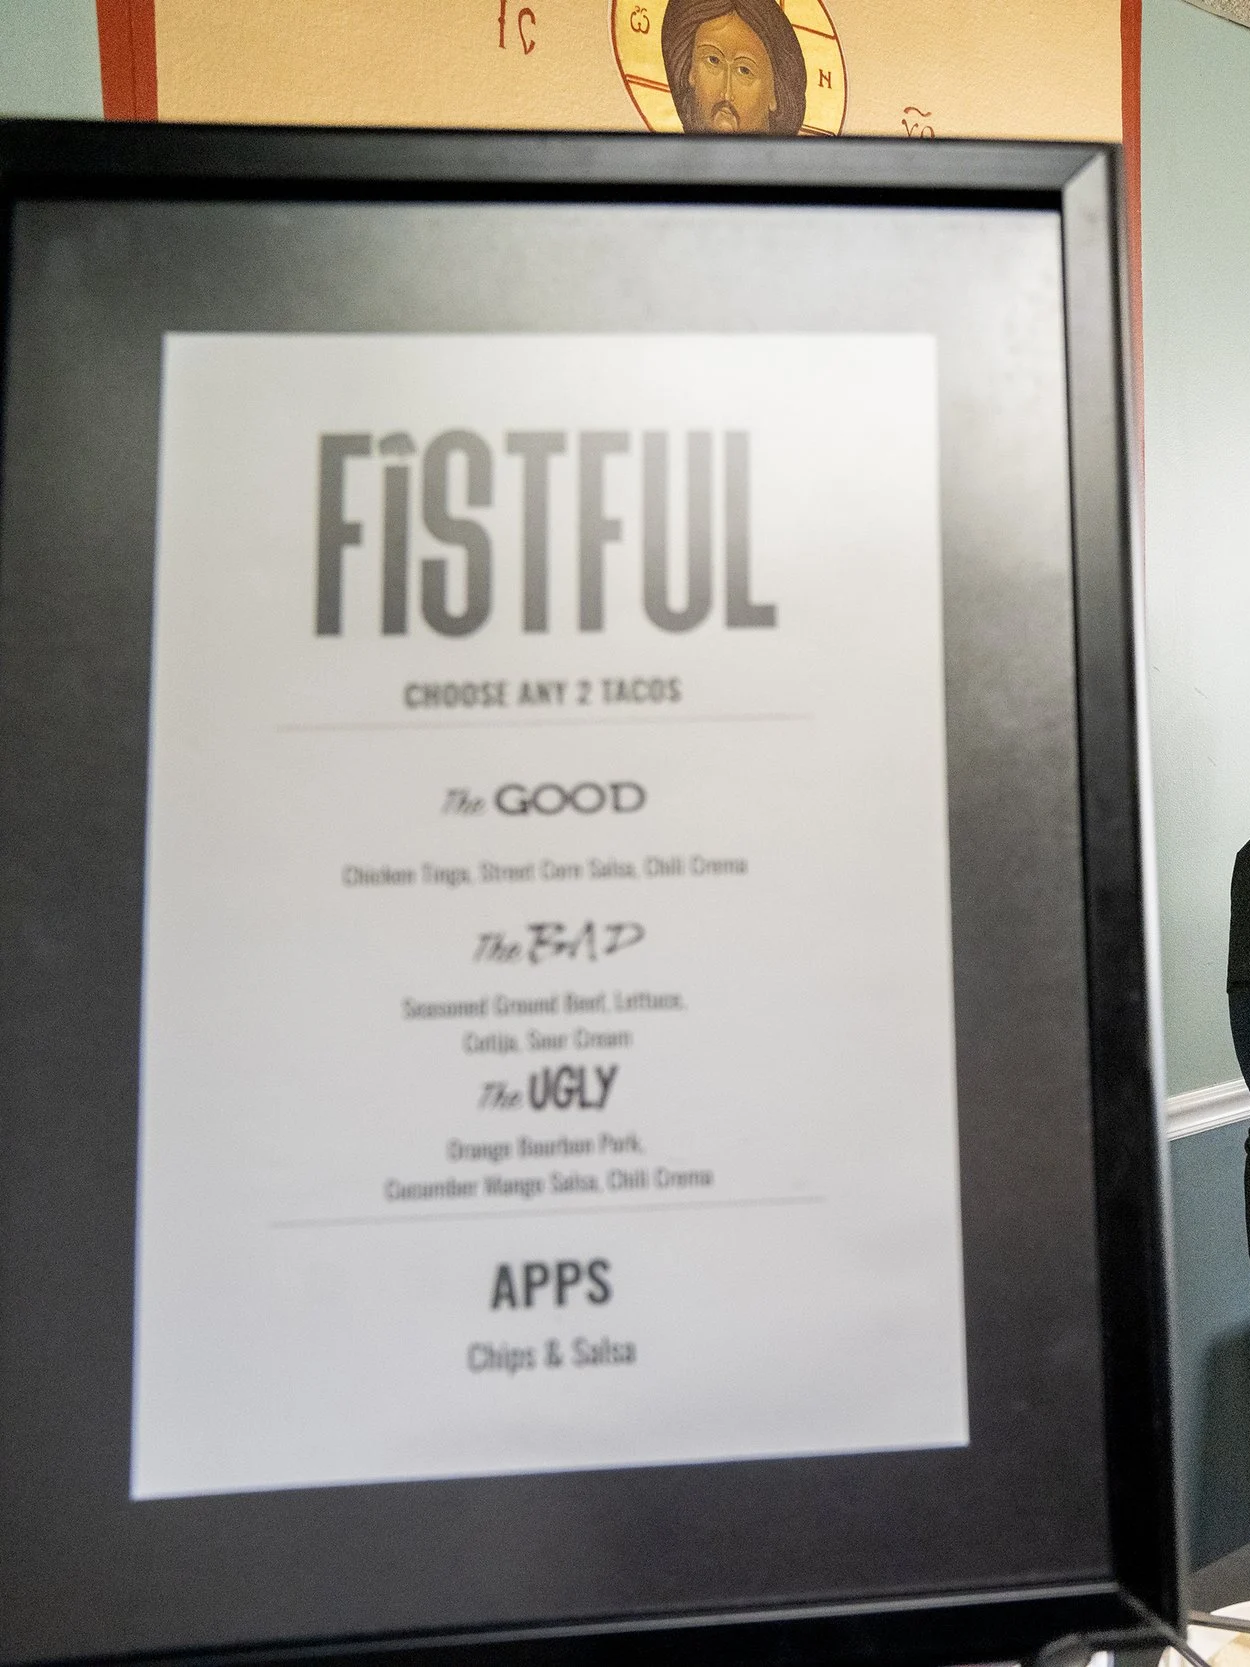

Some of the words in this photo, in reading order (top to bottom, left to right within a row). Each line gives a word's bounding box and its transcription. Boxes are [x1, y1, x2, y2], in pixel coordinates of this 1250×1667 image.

[403, 680, 507, 710] CHOOSE
[517, 681, 568, 705] ANY
[576, 679, 593, 706] 2
[601, 677, 682, 705] TACOS
[442, 788, 485, 816] The
[493, 781, 647, 817] GOOD
[342, 865, 416, 887] Chicken
[478, 861, 535, 883] Street
[643, 856, 685, 878] Chili
[688, 854, 748, 876] Crema
[474, 932, 521, 962] The
[527, 920, 645, 965] BAD
[402, 998, 489, 1020] Seasoned
[491, 994, 560, 1017] Ground
[527, 1029, 569, 1051] Sour
[573, 1027, 633, 1050] Cream
[479, 1081, 523, 1110] The
[528, 1064, 618, 1111] UGLY
[447, 1139, 512, 1164] Orange
[517, 1136, 595, 1158] Bourbon
[384, 1178, 479, 1202] Cucumber
[607, 1168, 649, 1191] Chili
[652, 1167, 714, 1189] Crema
[491, 1258, 612, 1310] APPS
[467, 1342, 537, 1376] Chips
[544, 1338, 564, 1368] &
[572, 1336, 637, 1368] Salsa
